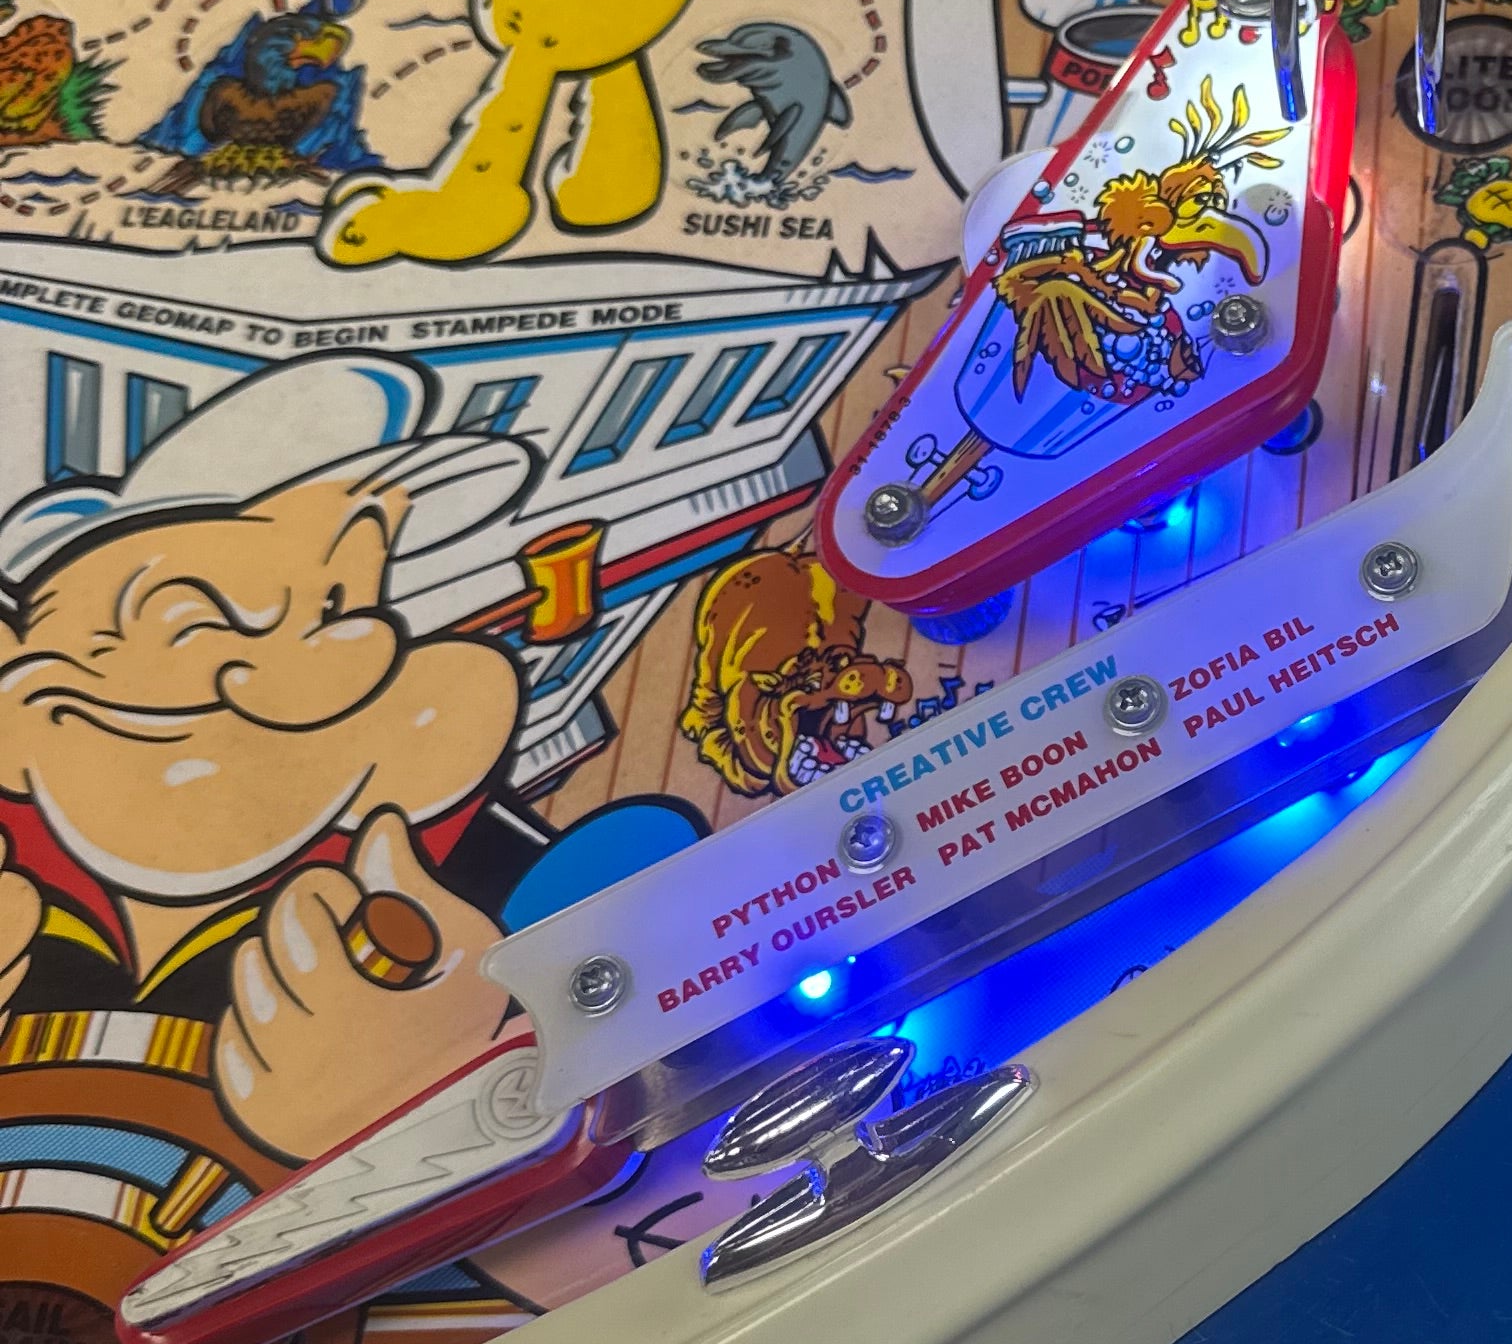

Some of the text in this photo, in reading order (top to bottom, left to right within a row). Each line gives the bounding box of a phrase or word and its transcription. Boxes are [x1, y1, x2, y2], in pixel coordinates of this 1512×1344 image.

[120, 207, 300, 233] L'EAGLELAND
[683, 213, 835, 241] SUSHI SEA
[115, 301, 236, 336] GEOMAP
[247, 324, 284, 346] TO
[295, 325, 390, 349] BEGIN
[411, 310, 578, 340] STAMPEDE
[591, 303, 684, 325] MODE
[712, 617, 1315, 939] PYTHON MIKE BOON ZOFIA BIL
[839, 655, 1118, 813] CREATIVE CREW
[657, 613, 1400, 1013] BARRY OURSLER PAT MCMAHON PAUL HEITSCH
